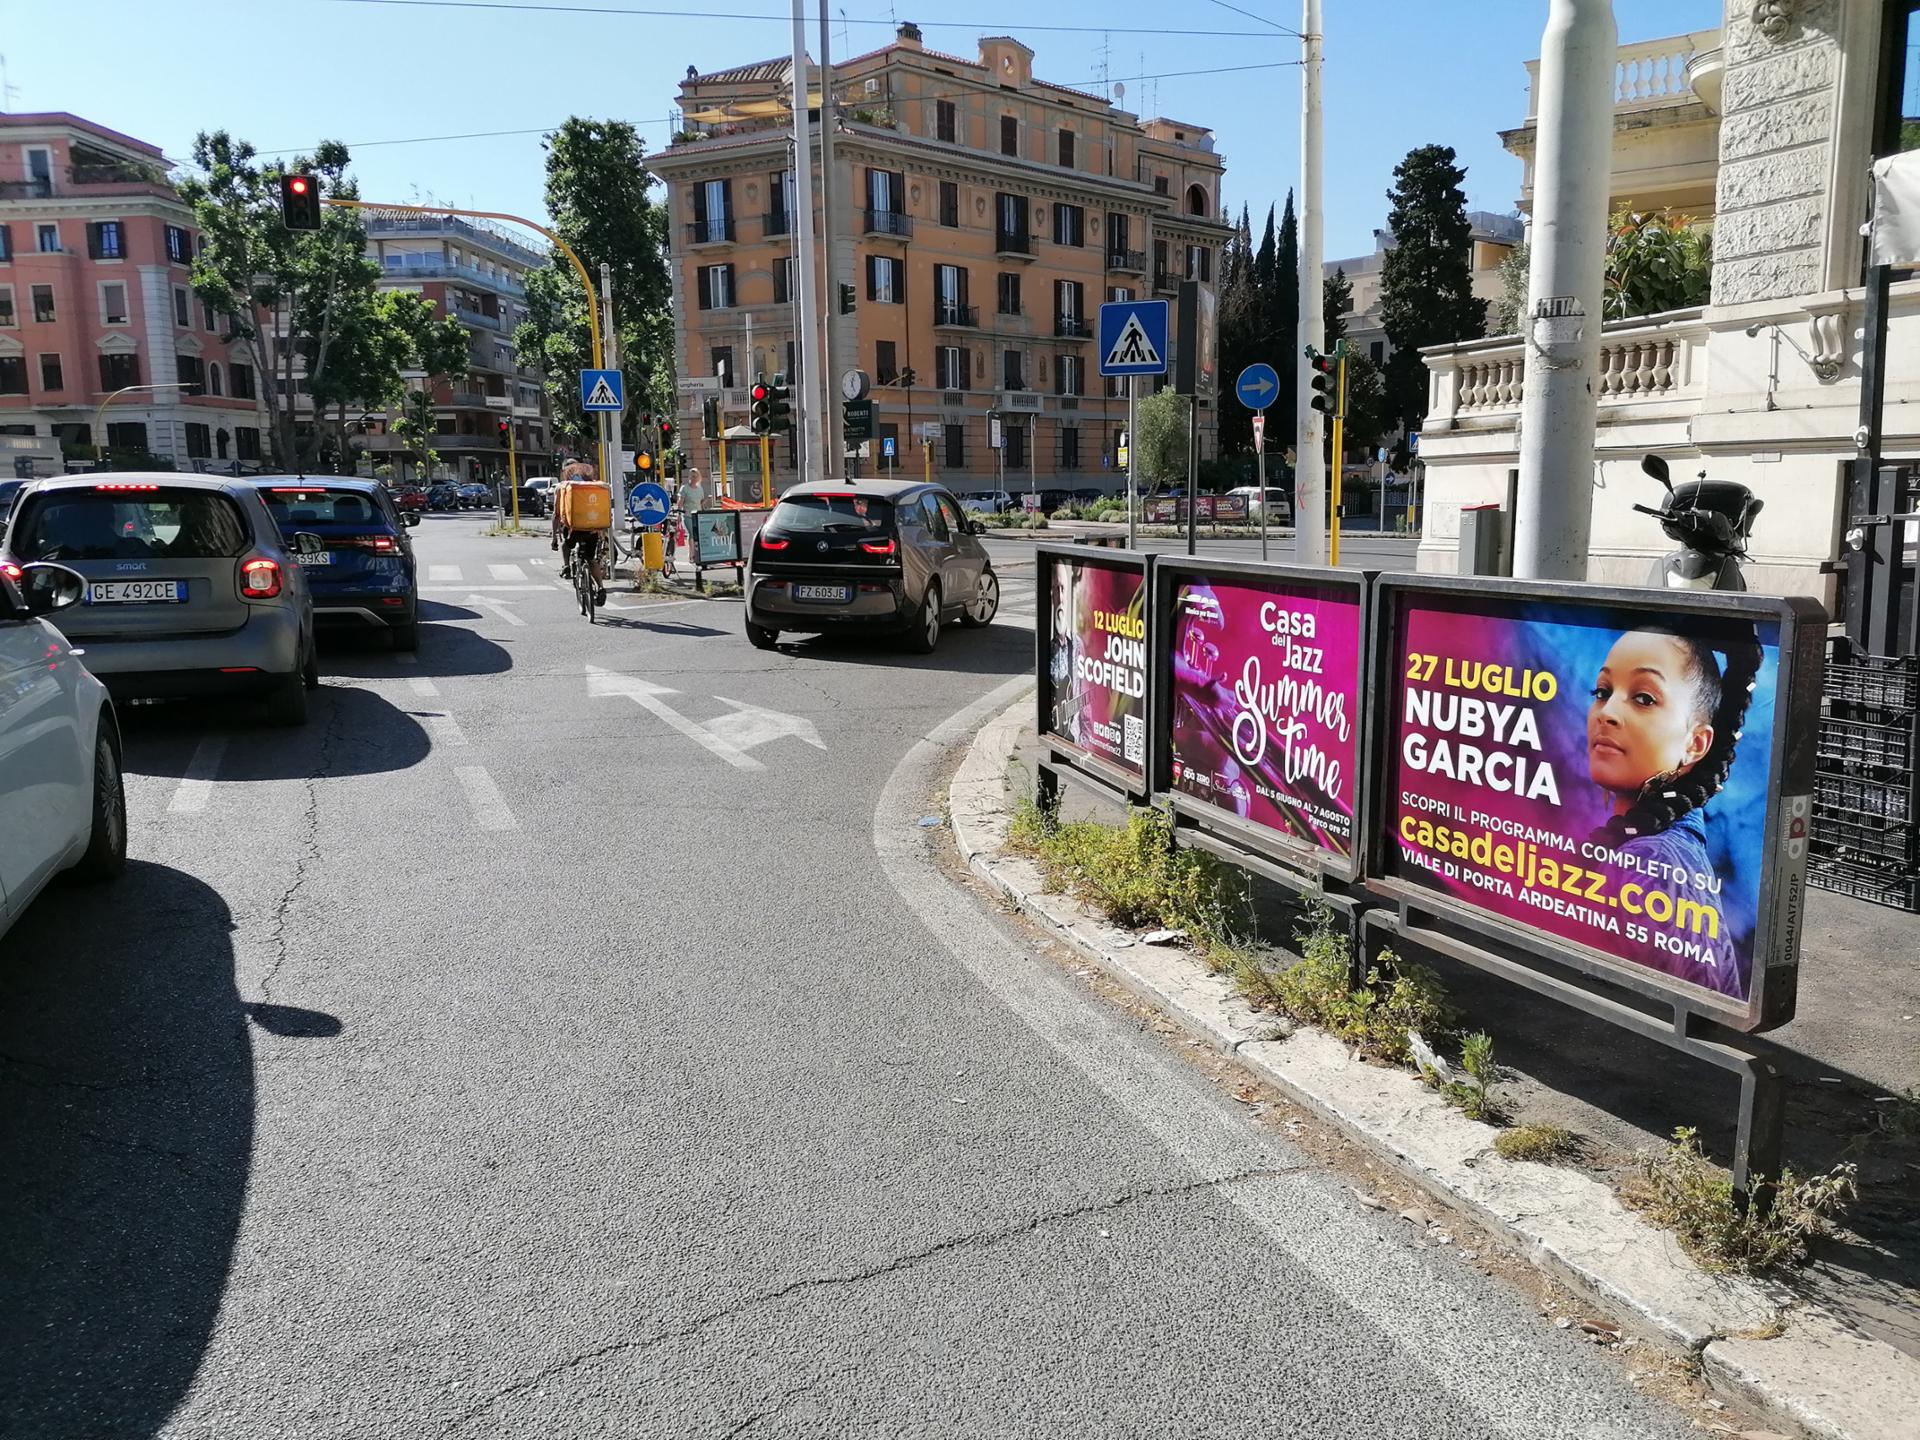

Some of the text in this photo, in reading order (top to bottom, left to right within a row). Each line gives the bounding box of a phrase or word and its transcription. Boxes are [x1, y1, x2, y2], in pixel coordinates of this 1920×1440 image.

[116, 562, 147, 571] smart
[94, 583, 175, 600] GE 492CE
[801, 586, 845, 598] FZ 603JE
[1094, 610, 1145, 640] 12 LUGLIO
[1260, 601, 1316, 639] Casa
[1271, 634, 1286, 647] del
[1104, 635, 1144, 669] JOHN
[1282, 635, 1323, 674] Jazz
[1077, 655, 1144, 699] SCOFIELD
[1406, 652, 1558, 702] 27 LUGLIO
[1232, 656, 1351, 766] Summer
[1405, 687, 1543, 751] NUBYA
[1403, 732, 1562, 806] GARCIA
[1256, 784, 1269, 797] DAL
[1270, 790, 1275, 799] 5
[1276, 792, 1302, 809] GIUGNO
[1303, 803, 1313, 813] AL
[1313, 805, 1319, 814] 7
[1319, 807, 1350, 826] AGOSTO
[1308, 814, 1350, 838] Parco ore 21
[1401, 791, 1722, 894] SCOPRI IL PROGRAMMA COMPLETO SU
[1788, 795, 1807, 860] apa
[1400, 815, 1720, 940] casadeljazz.com
[1401, 847, 1717, 967] VIALE DI PORTA ARDEATINA 55 ROMA
